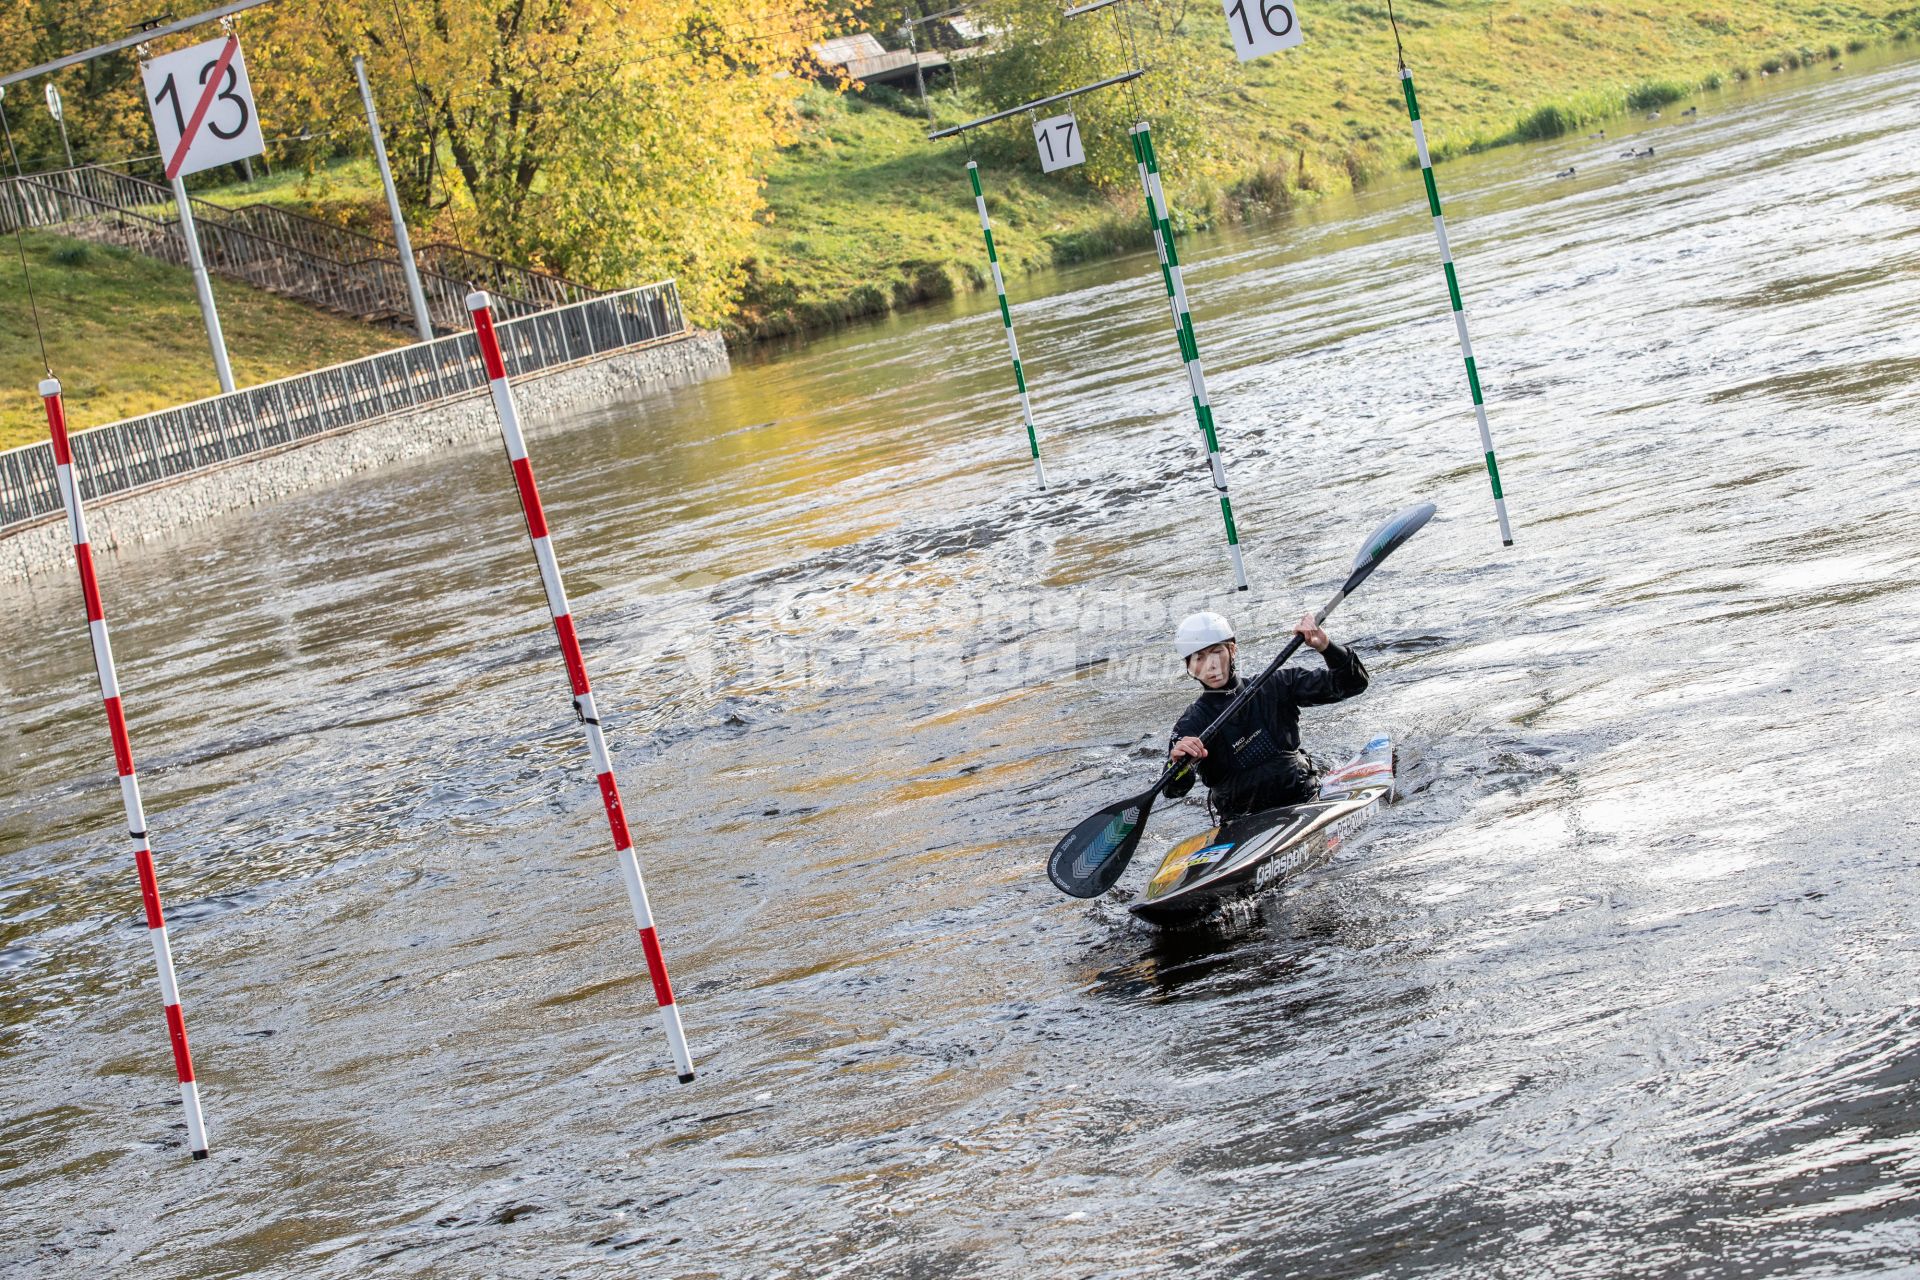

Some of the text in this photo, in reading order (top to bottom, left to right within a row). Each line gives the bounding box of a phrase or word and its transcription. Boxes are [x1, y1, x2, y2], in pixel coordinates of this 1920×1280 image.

[1228, 0, 1293, 44] 16
[155, 60, 249, 149] 13
[1039, 122, 1073, 162] 17
[1254, 842, 1310, 891] galasport
